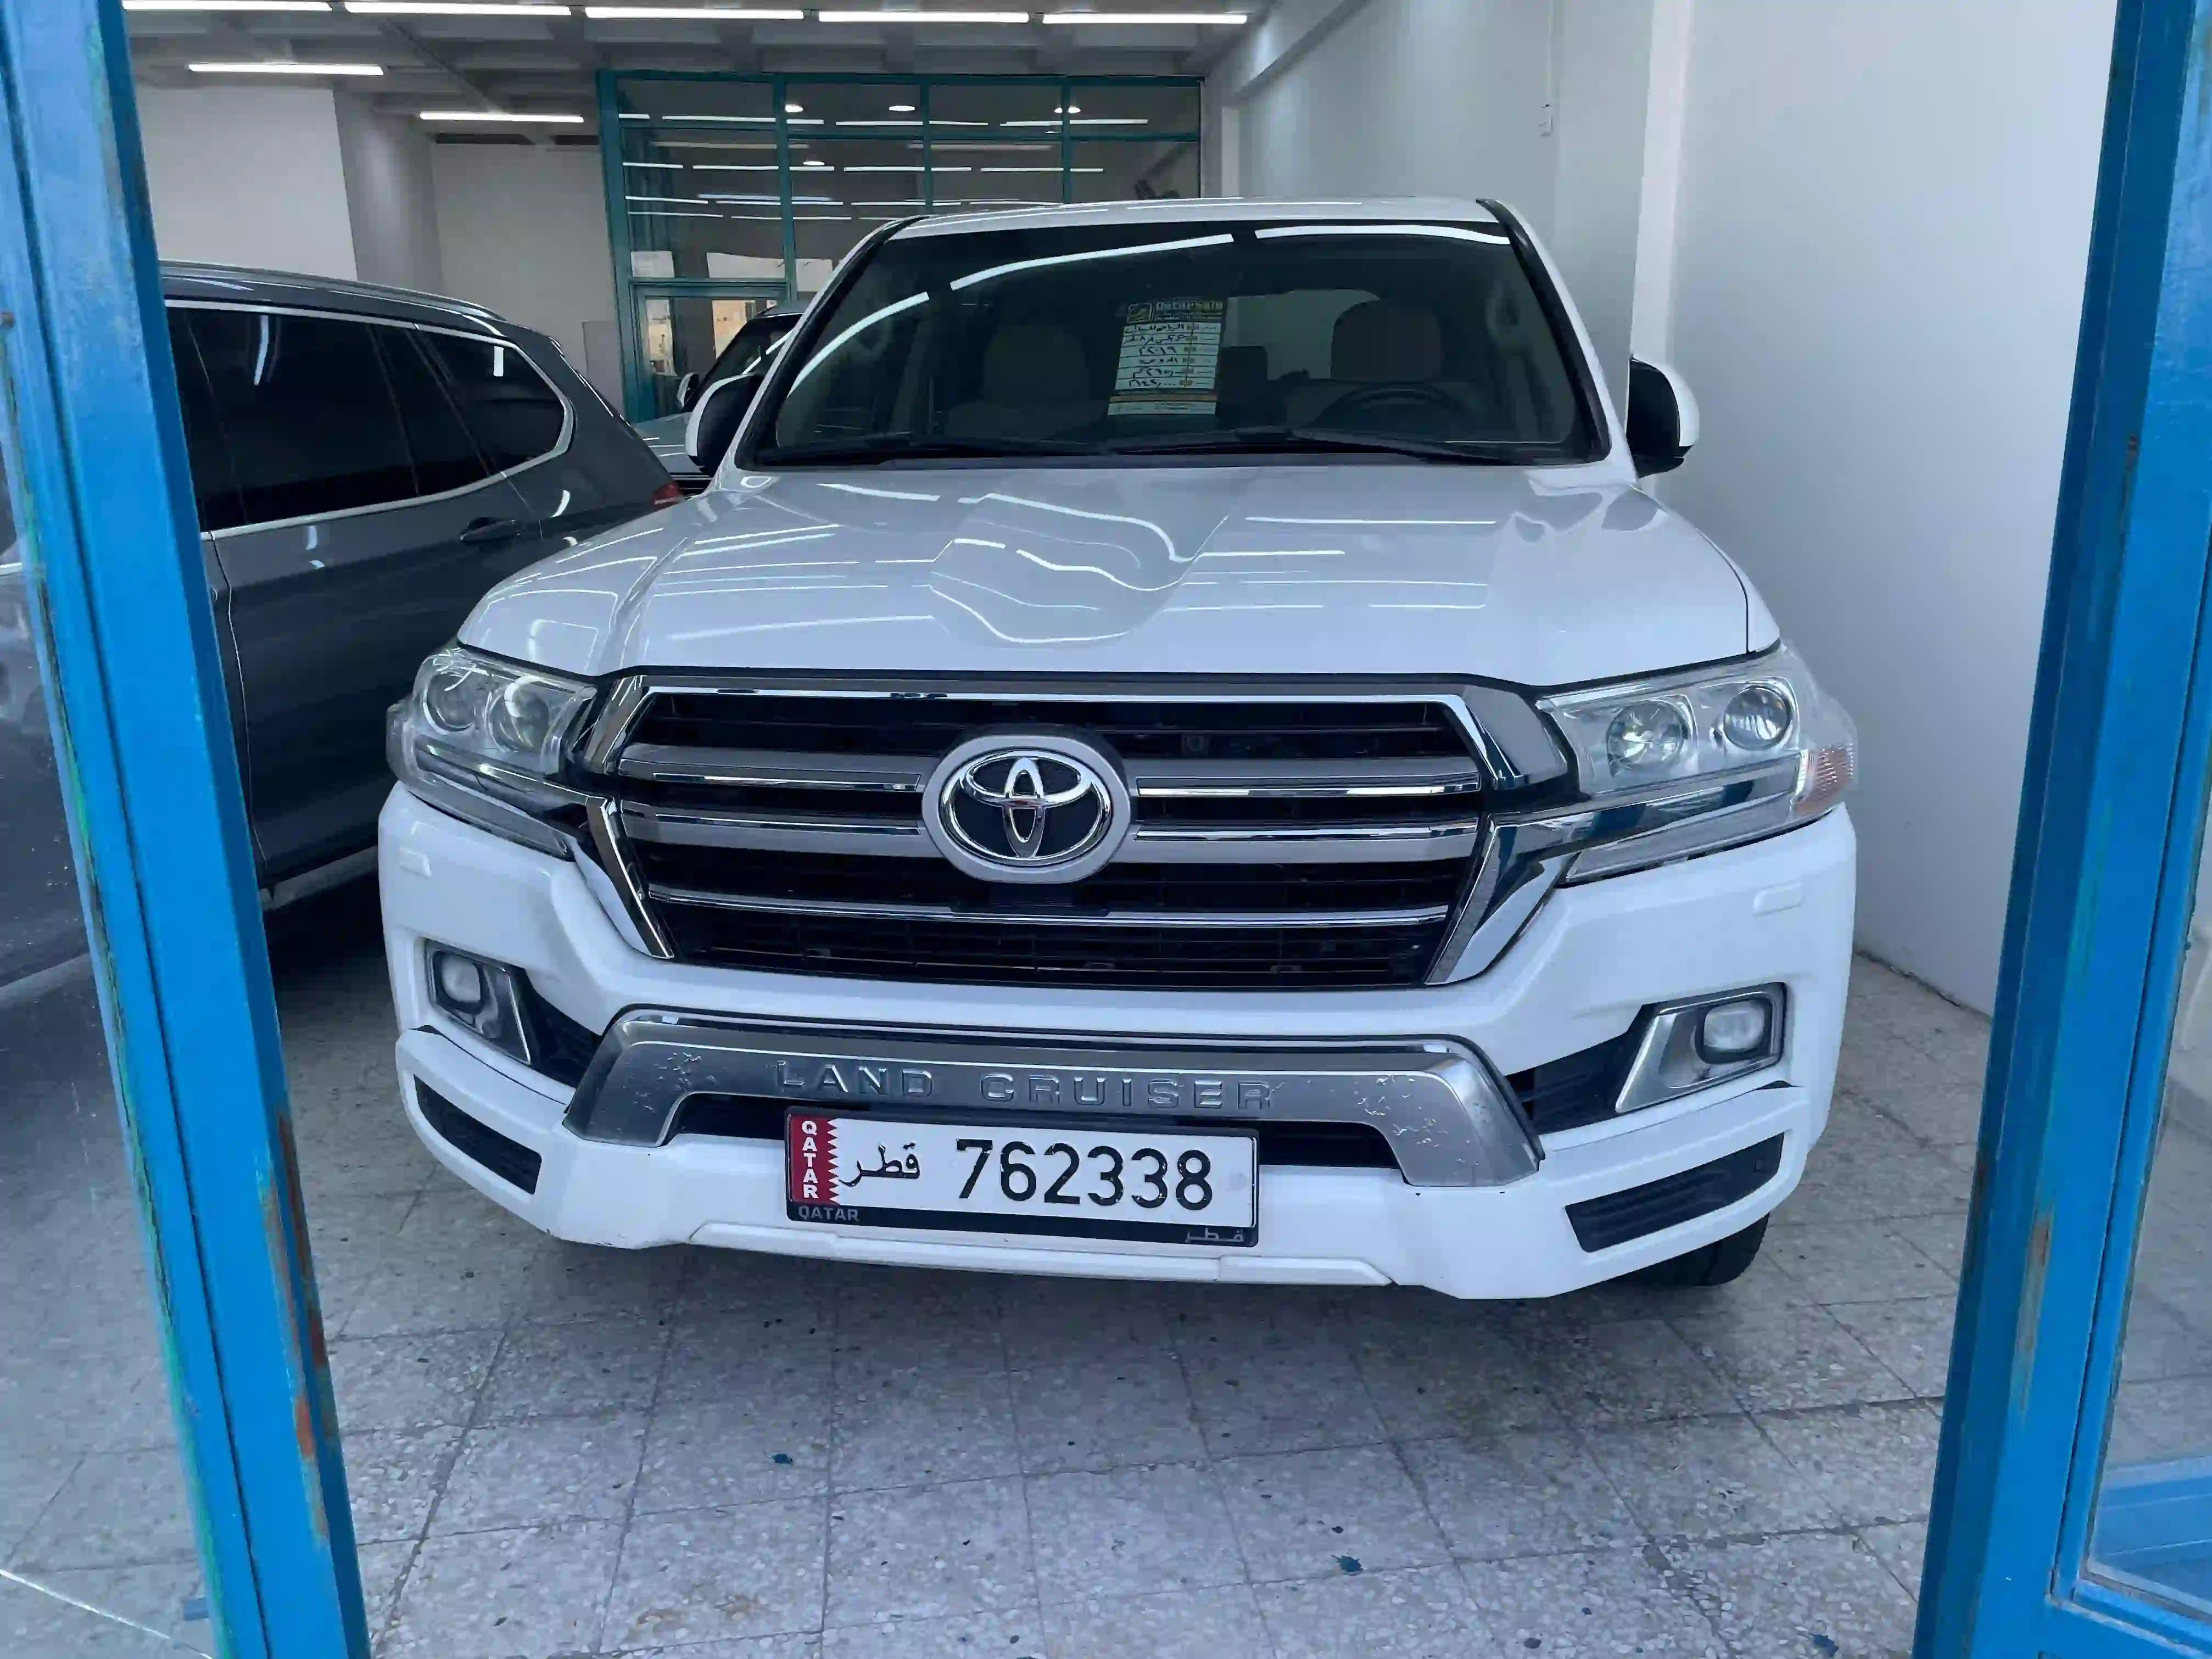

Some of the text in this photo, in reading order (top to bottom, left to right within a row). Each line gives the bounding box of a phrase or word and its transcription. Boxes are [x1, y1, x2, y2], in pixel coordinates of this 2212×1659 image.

[777, 1060, 1271, 1110] LAND CRUISER
[801, 1120, 819, 1199] QATAR
[838, 1142, 920, 1187] قطر
[956, 1138, 1213, 1211] 762338
[798, 1205, 859, 1222] QATAR
[1185, 1227, 1244, 1243] قطر
